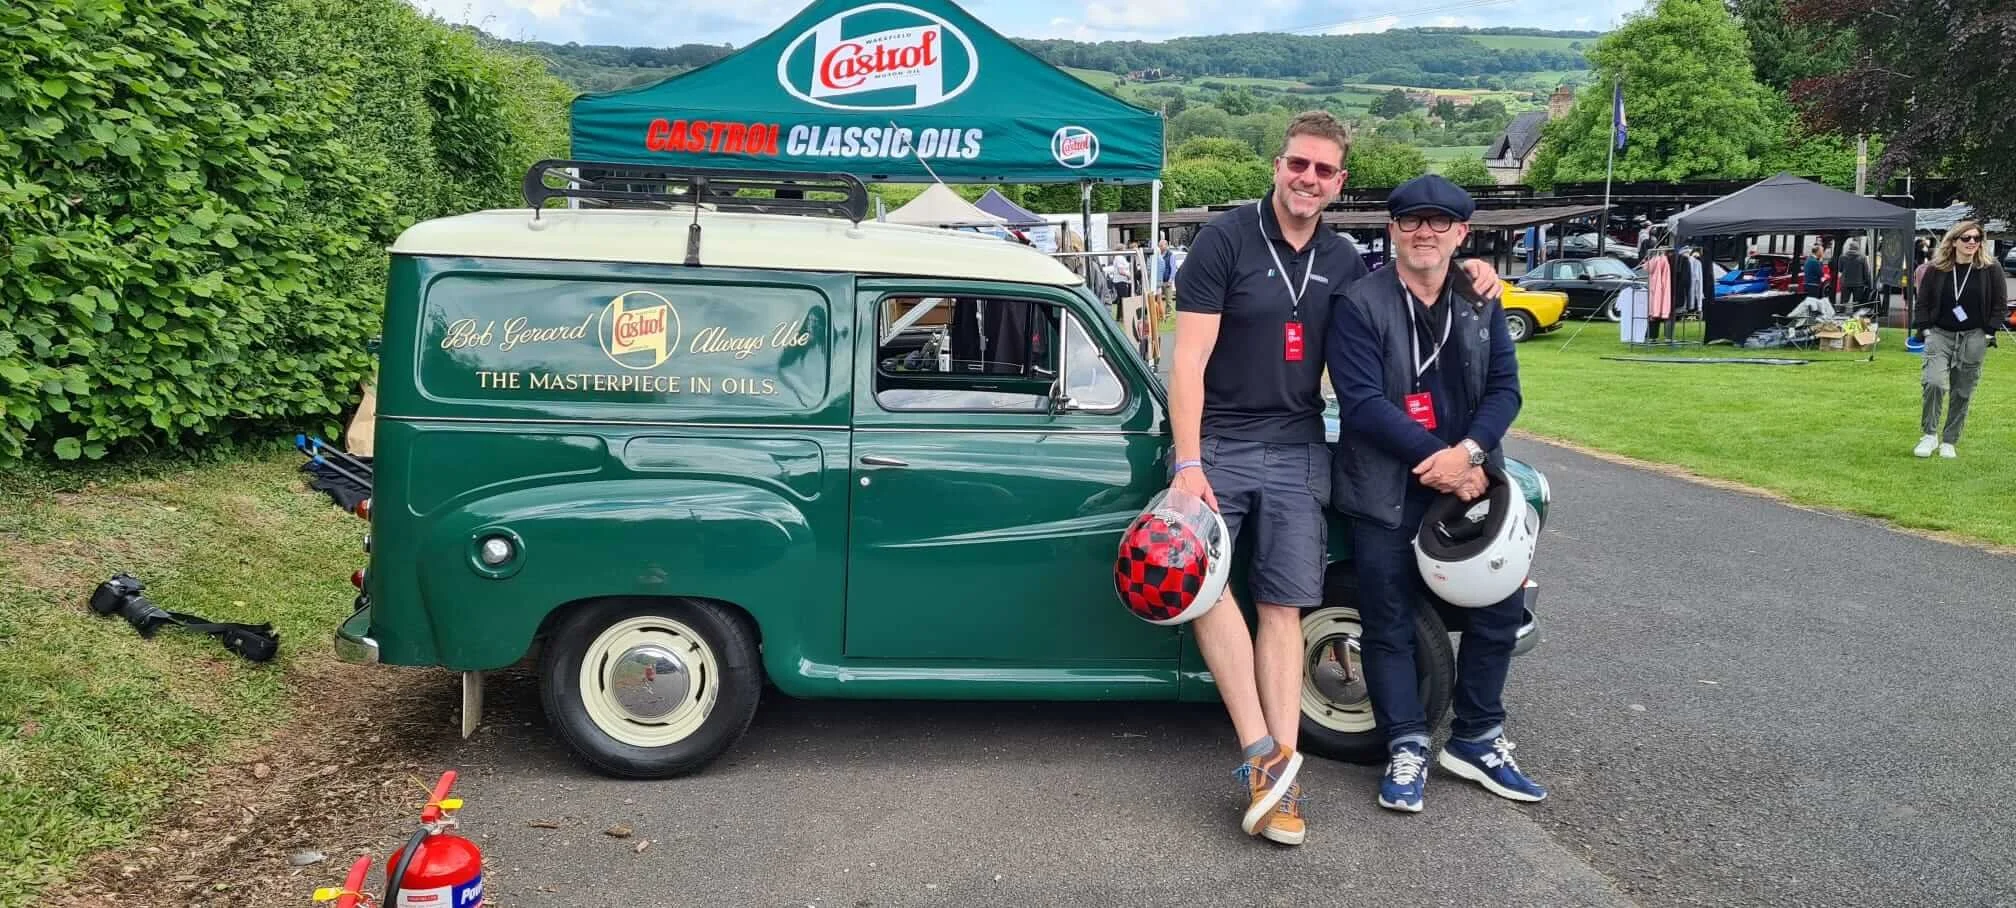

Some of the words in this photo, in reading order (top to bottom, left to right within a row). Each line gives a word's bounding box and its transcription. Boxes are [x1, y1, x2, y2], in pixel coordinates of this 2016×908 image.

[819, 30, 938, 90] Castrol
[646, 118, 780, 157] CASTROL
[786, 125, 913, 158] CLASSIC
[917, 128, 983, 159] OILS
[440, 318, 496, 349] Bob
[499, 313, 594, 352] Gerard
[614, 308, 666, 347] Castrol
[690, 326, 765, 360] Always
[771, 320, 809, 347] Use
[475, 371, 521, 389] THE
[529, 372, 681, 394] MASTERPIECE
[690, 376, 711, 393] IN
[722, 378, 779, 395] OILS.
